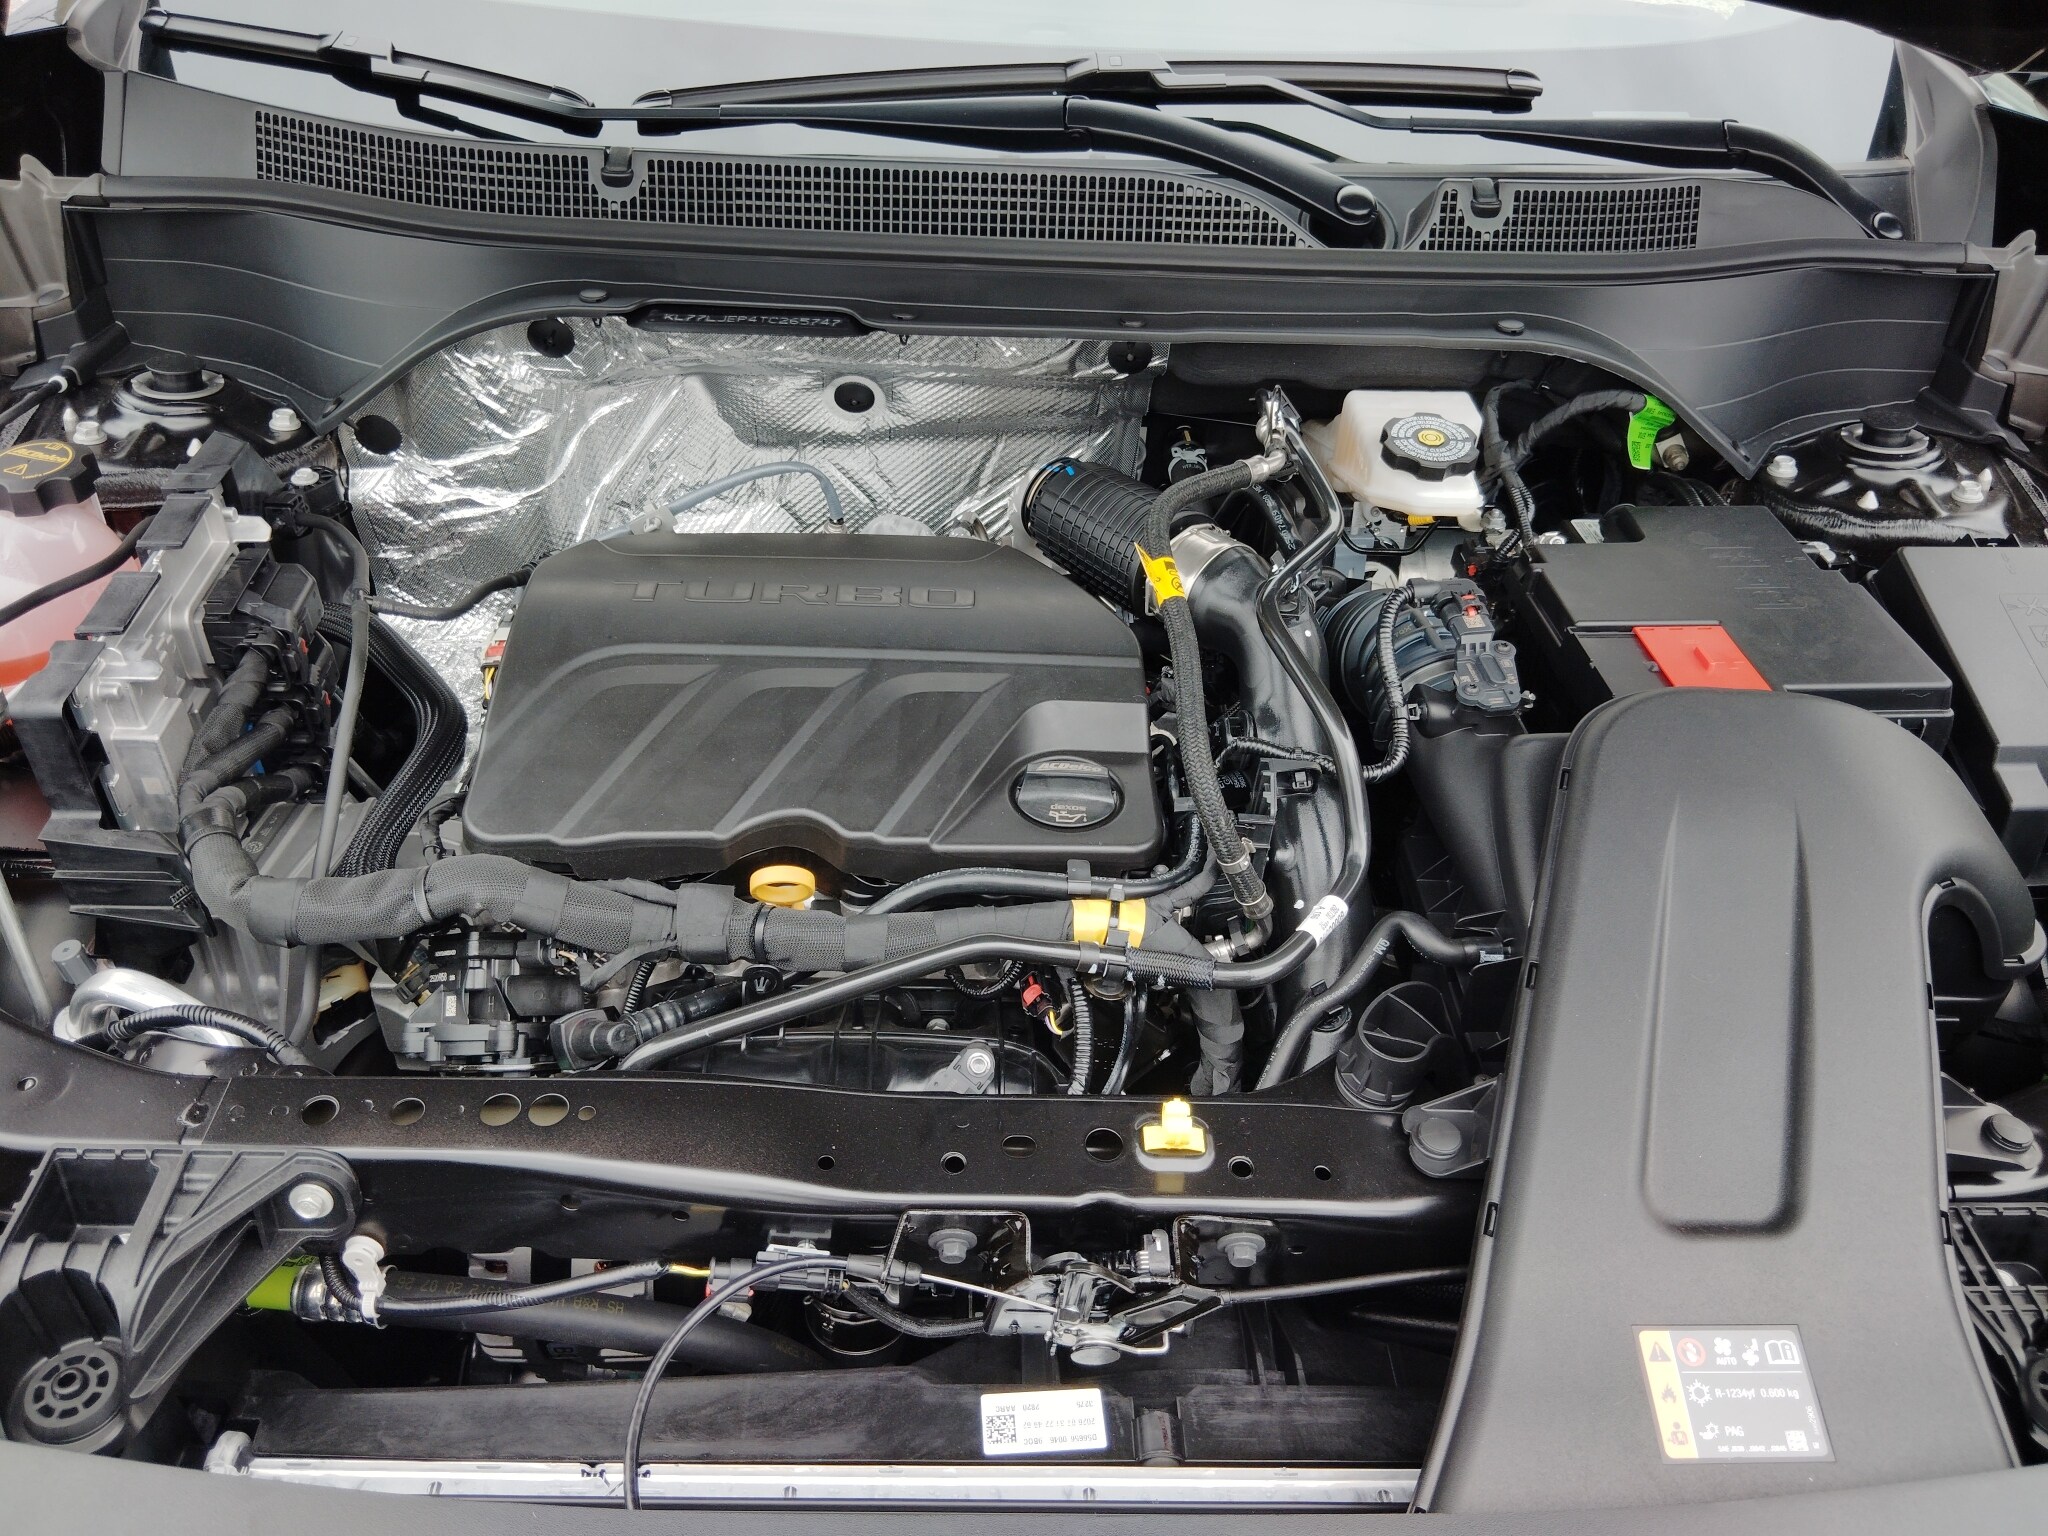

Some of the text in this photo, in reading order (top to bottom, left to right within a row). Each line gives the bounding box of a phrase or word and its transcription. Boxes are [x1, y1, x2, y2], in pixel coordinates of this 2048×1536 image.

[613, 580, 976, 610] TURBO
[1036, 762, 1102, 773] ACDelco
[1050, 803, 1088, 812] dexos
[1716, 1356, 1738, 1366] AUTO
[1714, 1388, 1755, 1401] R-1234yf
[1787, 1388, 1800, 1400] kg
[1724, 1426, 1745, 1437] PAG
